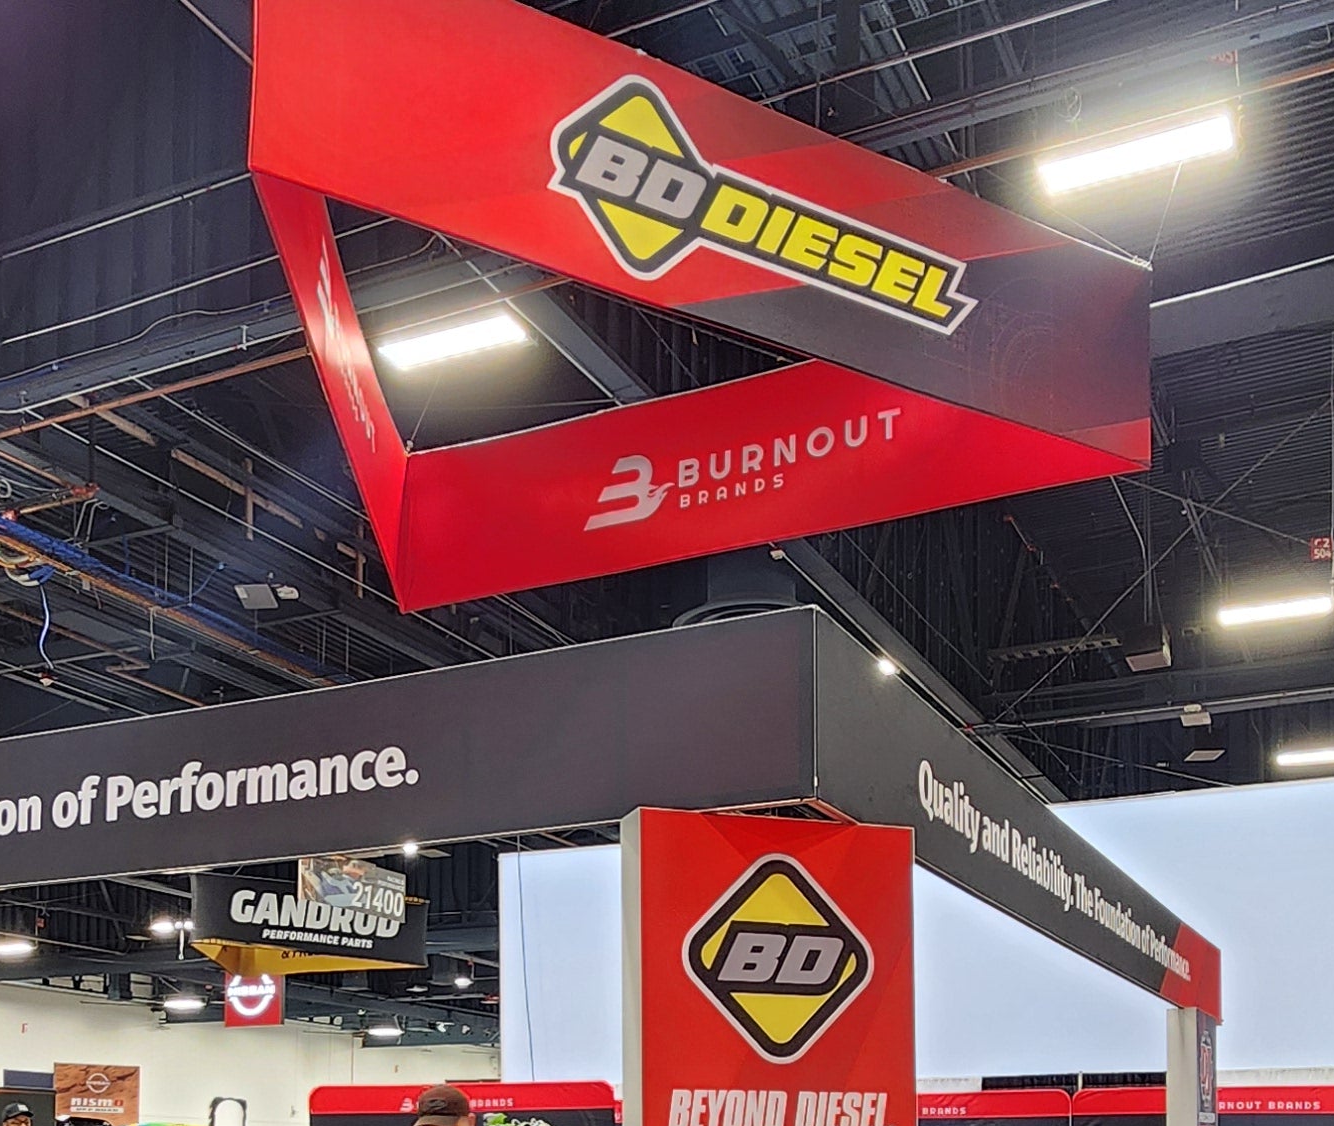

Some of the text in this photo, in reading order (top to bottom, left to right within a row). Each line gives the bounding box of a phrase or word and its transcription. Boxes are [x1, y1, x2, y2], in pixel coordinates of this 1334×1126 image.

[575, 136, 953, 318] BD DIESEL
[679, 407, 901, 488] BURNOUT
[680, 473, 784, 508] BRANDS
[52, 774, 99, 828] of
[105, 746, 419, 822] Performance.
[918, 760, 981, 854] Quality
[982, 815, 1010, 864] and
[1012, 827, 1074, 912] Reliability.
[1074, 872, 1094, 917] The
[1094, 886, 1141, 950] Foundation
[1141, 924, 1151, 954] of
[351, 882, 404, 917] 21400
[262, 929, 373, 949] PERFORMANCE PARTS
[717, 932, 845, 985] BD
[228, 985, 275, 997] NISSAN
[922, 1107, 966, 1115] BRANDS
[1218, 1100, 1321, 1110] RNOUT BRANDS
